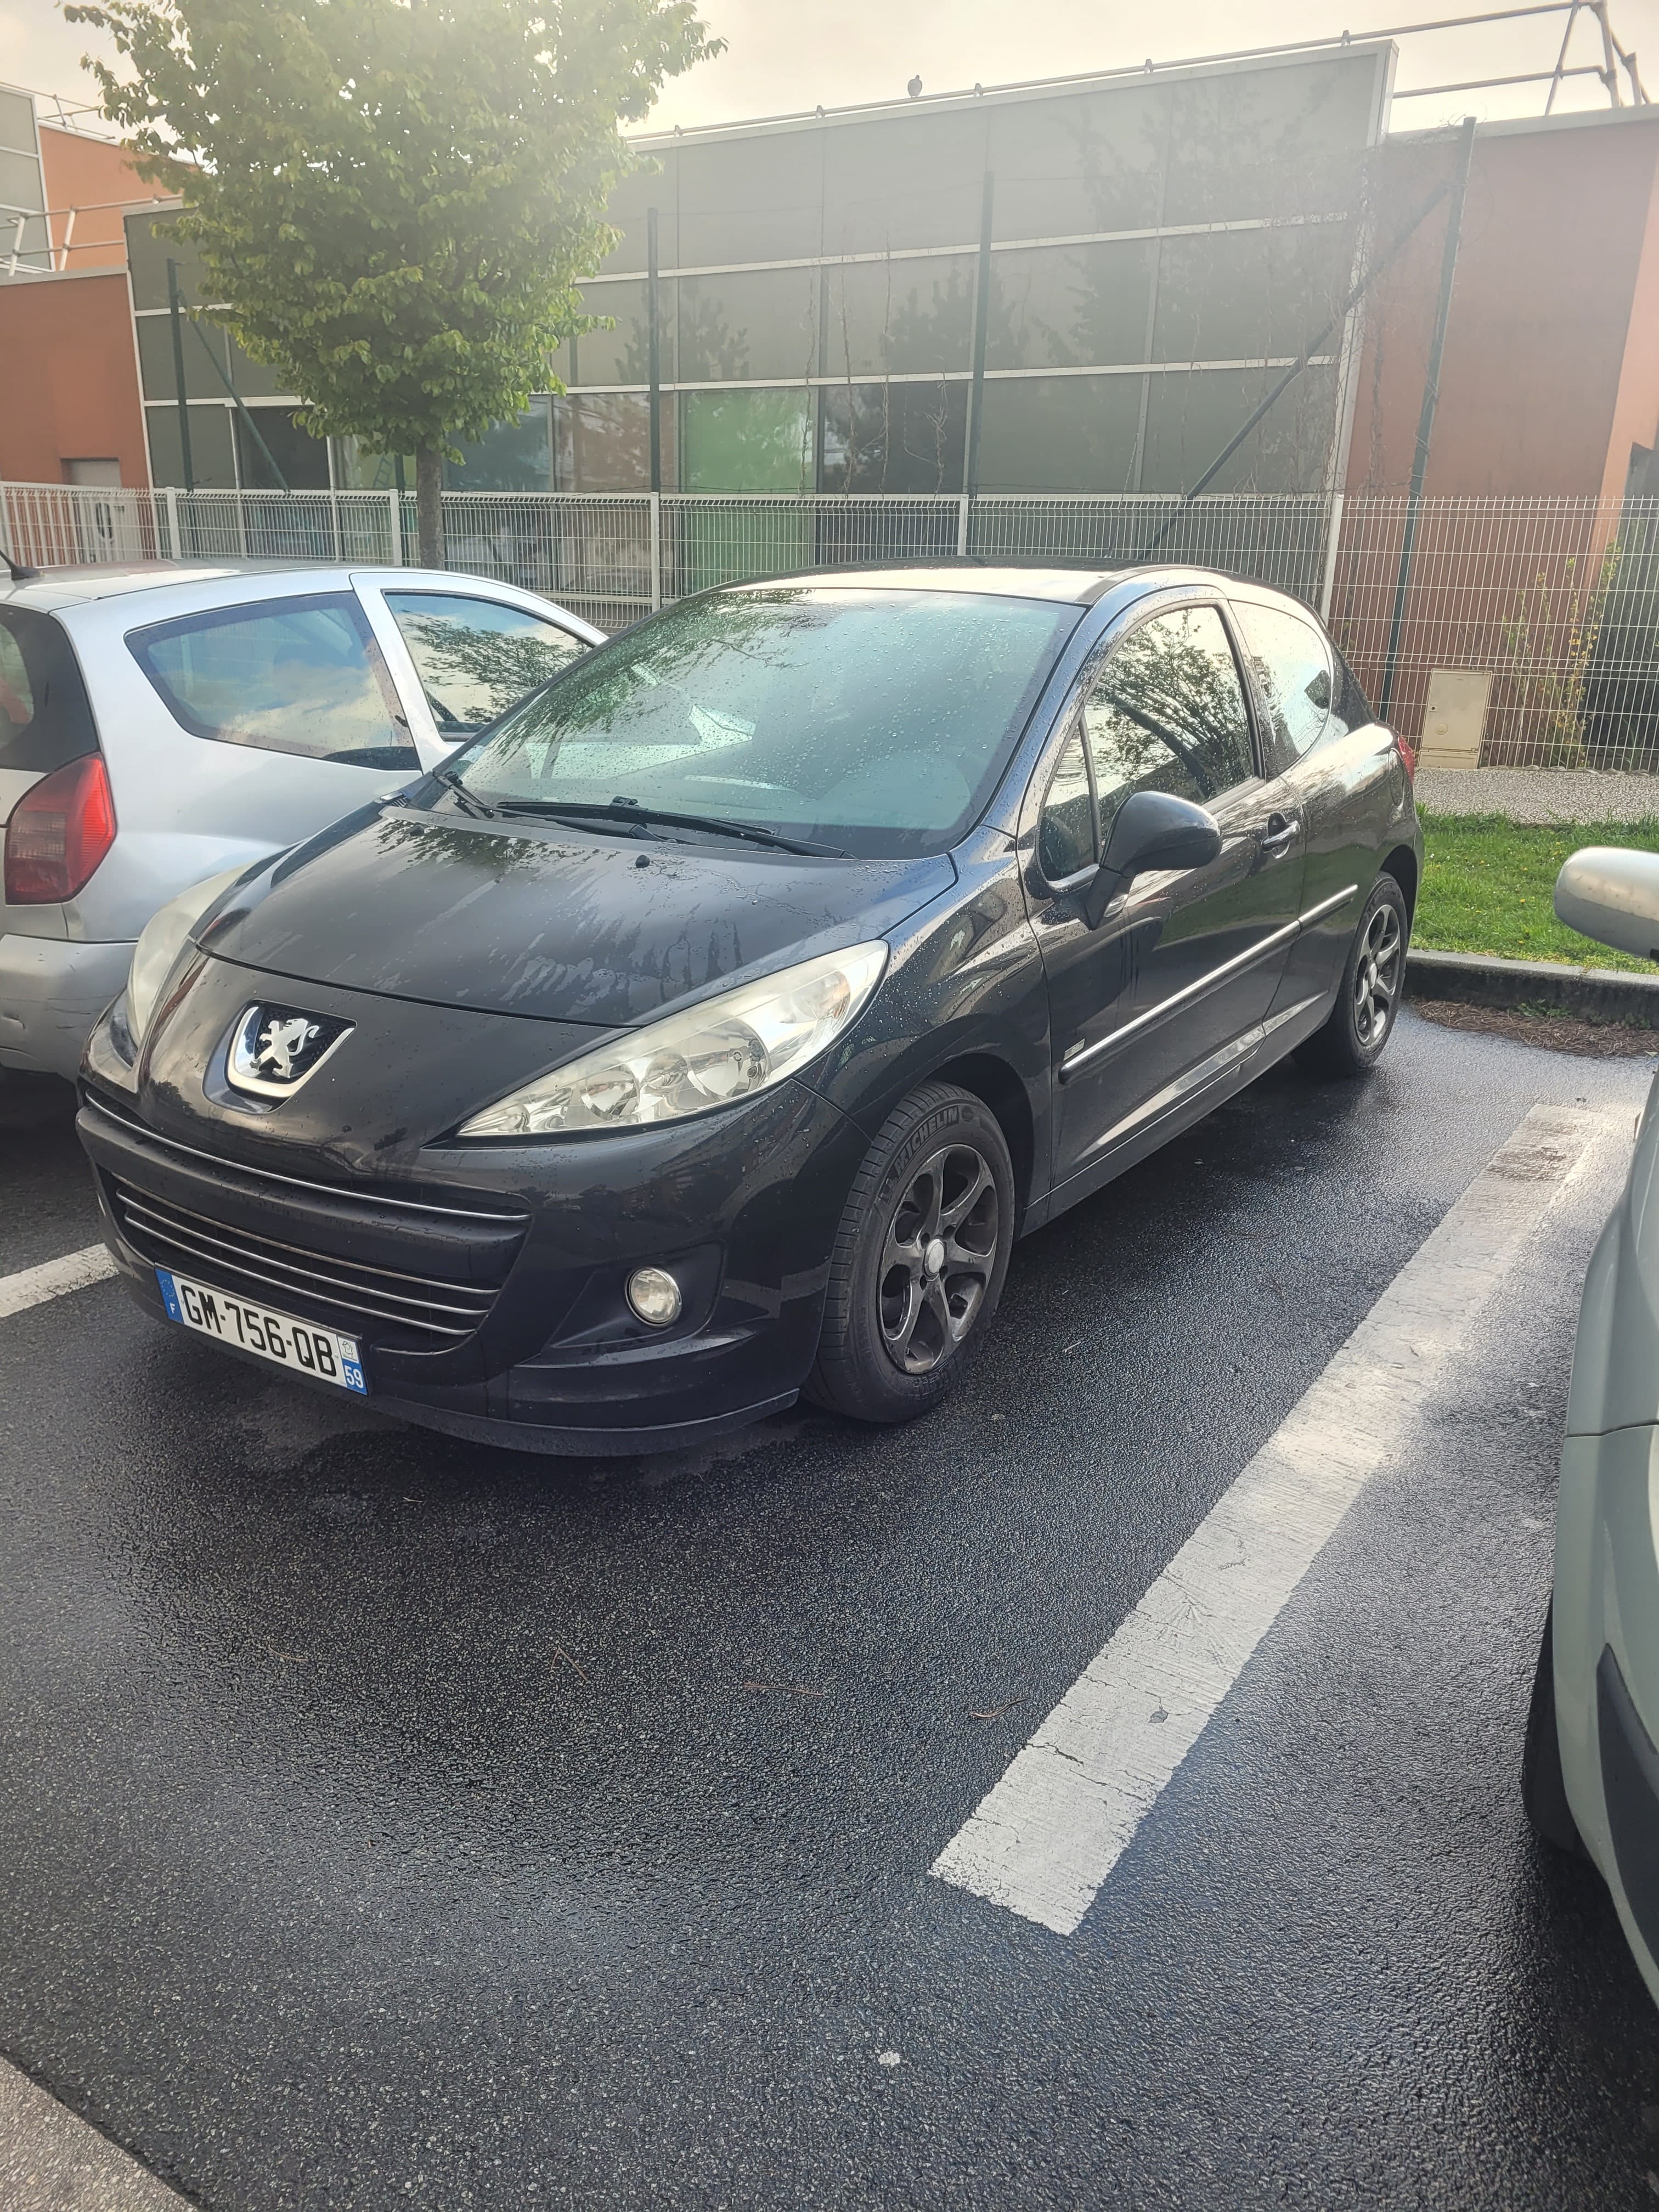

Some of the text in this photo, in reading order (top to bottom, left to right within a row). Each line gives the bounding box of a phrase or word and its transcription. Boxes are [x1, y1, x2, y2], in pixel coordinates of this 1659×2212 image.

[895, 1105, 958, 1177] MICHELIN
[170, 1302, 175, 1314] F
[181, 1285, 336, 1377] GM-756-QB
[345, 1365, 363, 1388] 59
